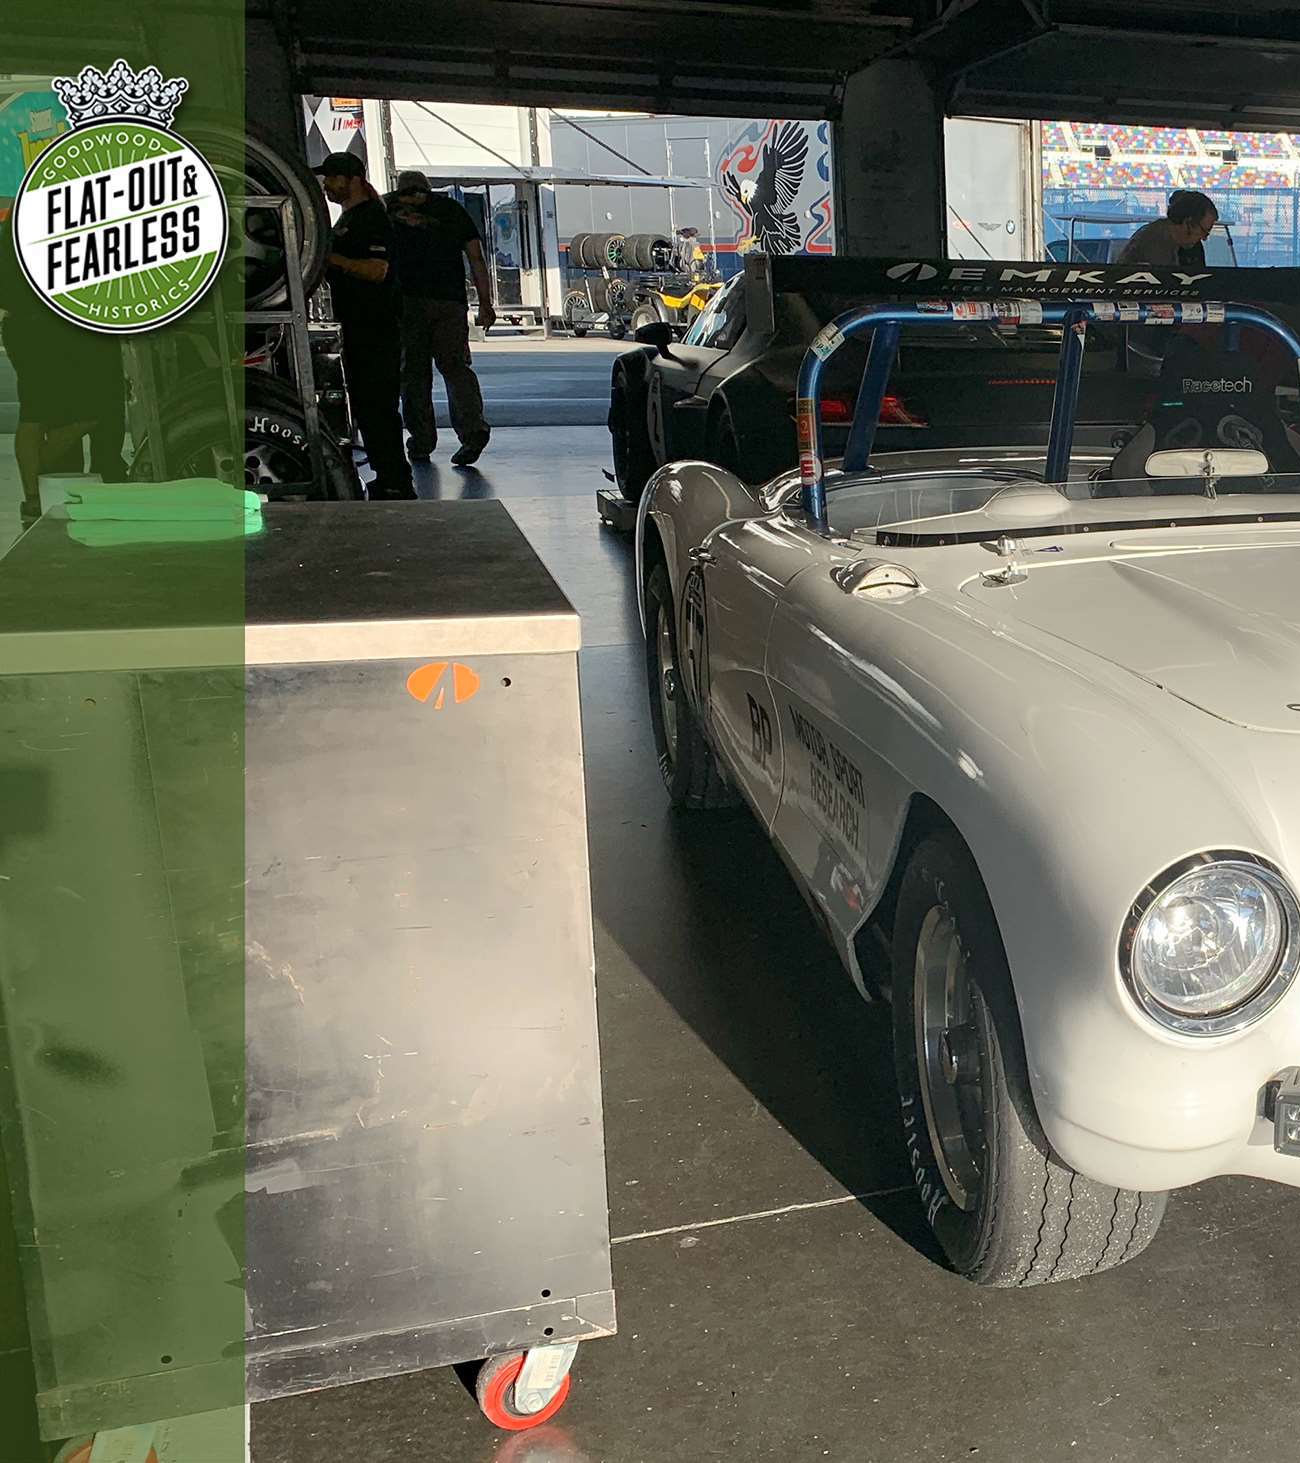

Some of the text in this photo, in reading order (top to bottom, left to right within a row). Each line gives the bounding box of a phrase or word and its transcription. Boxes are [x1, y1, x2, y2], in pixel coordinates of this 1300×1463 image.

[948, 267, 1213, 285] EMKAY
[1001, 286, 1116, 295] MANAGEMENT
[1122, 288, 1200, 297] SERVICES
[1183, 377, 1253, 394] Racetech
[747, 692, 772, 770] BP
[788, 705, 866, 809] MOTOR SPORT
[810, 761, 860, 851] RESEARCH
